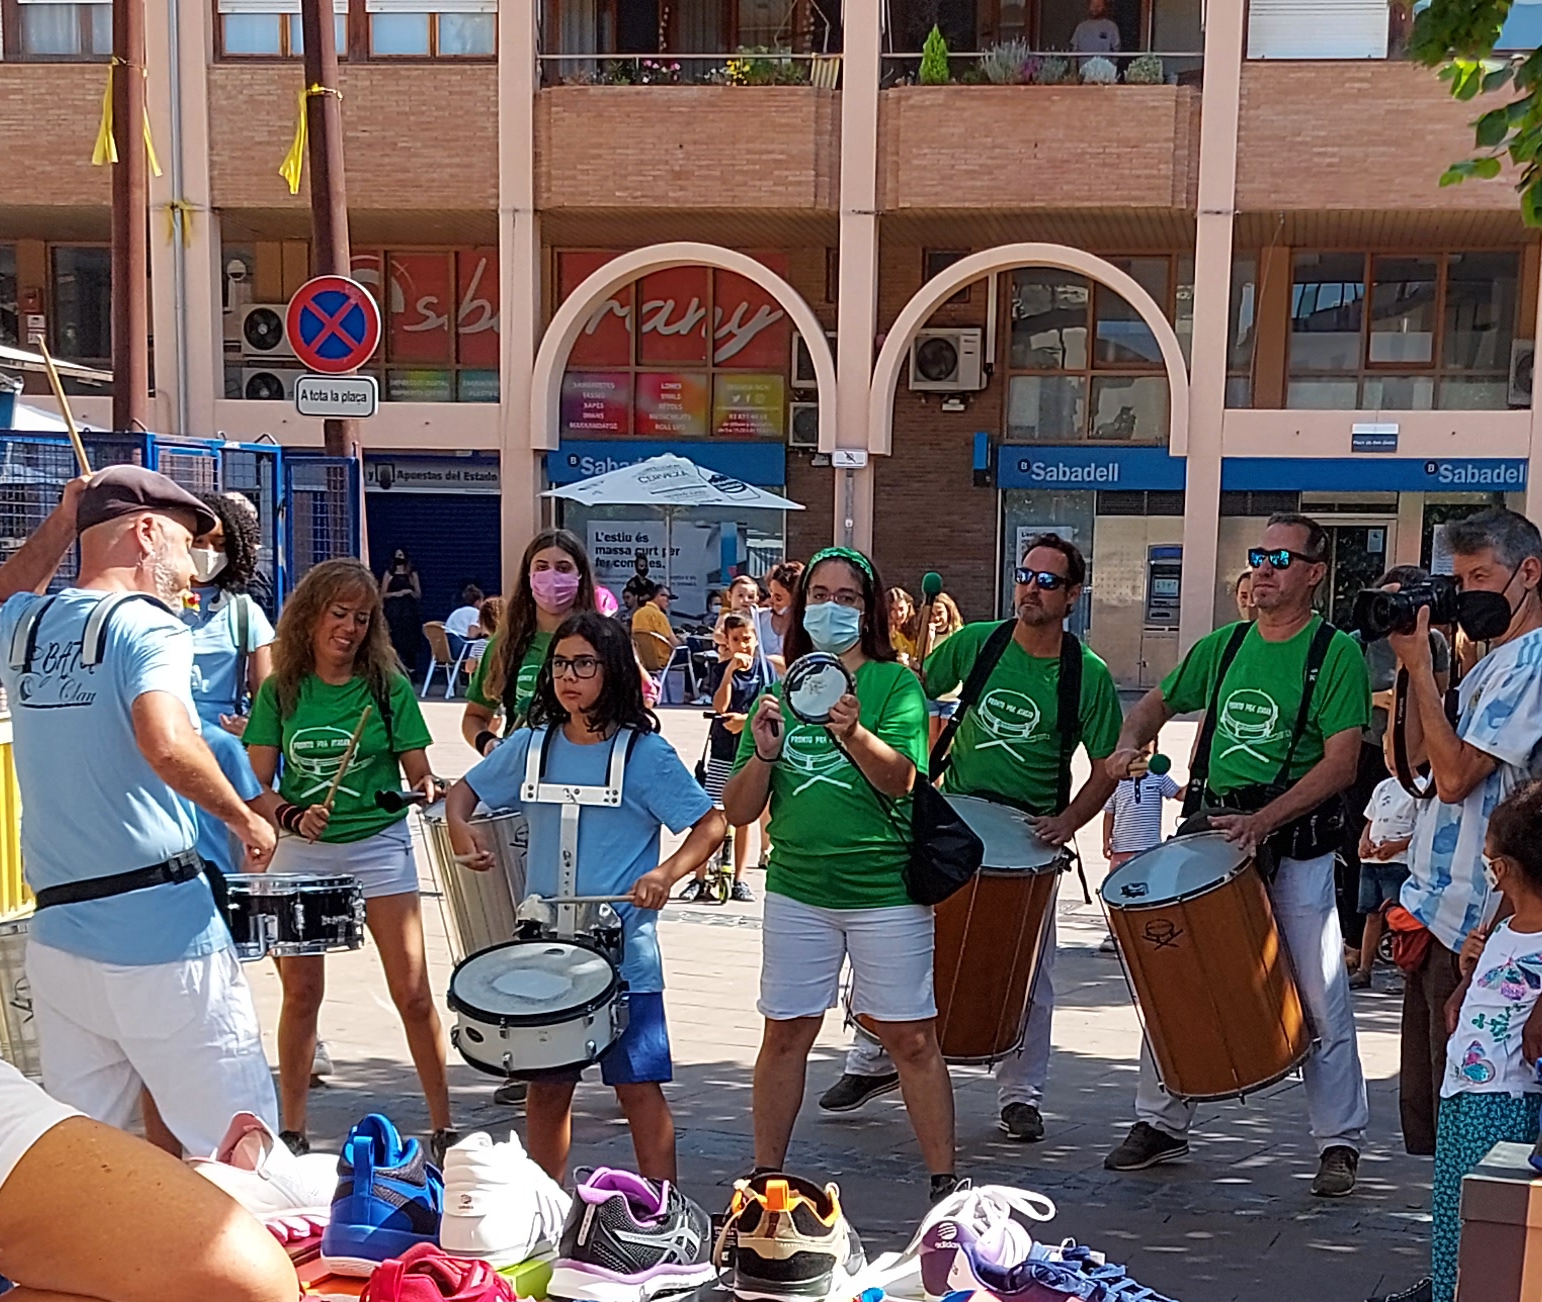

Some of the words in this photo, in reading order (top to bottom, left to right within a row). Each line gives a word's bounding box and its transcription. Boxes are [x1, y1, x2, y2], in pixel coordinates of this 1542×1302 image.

[301, 389, 308, 401] A
[309, 390, 328, 402] tota
[331, 389, 338, 402] la
[341, 390, 367, 405] plaça
[368, 471, 374, 481] y
[396, 470, 442, 482] Apuestas
[445, 470, 460, 481] del
[464, 471, 498, 482] Estado
[1031, 462, 1119, 482] Sabadell
[595, 532, 632, 543] L'estiu
[635, 532, 649, 543] és
[595, 546, 631, 556] massa
[634, 546, 659, 556] curt
[595, 557, 610, 568] fer
[613, 559, 666, 569] comes.
